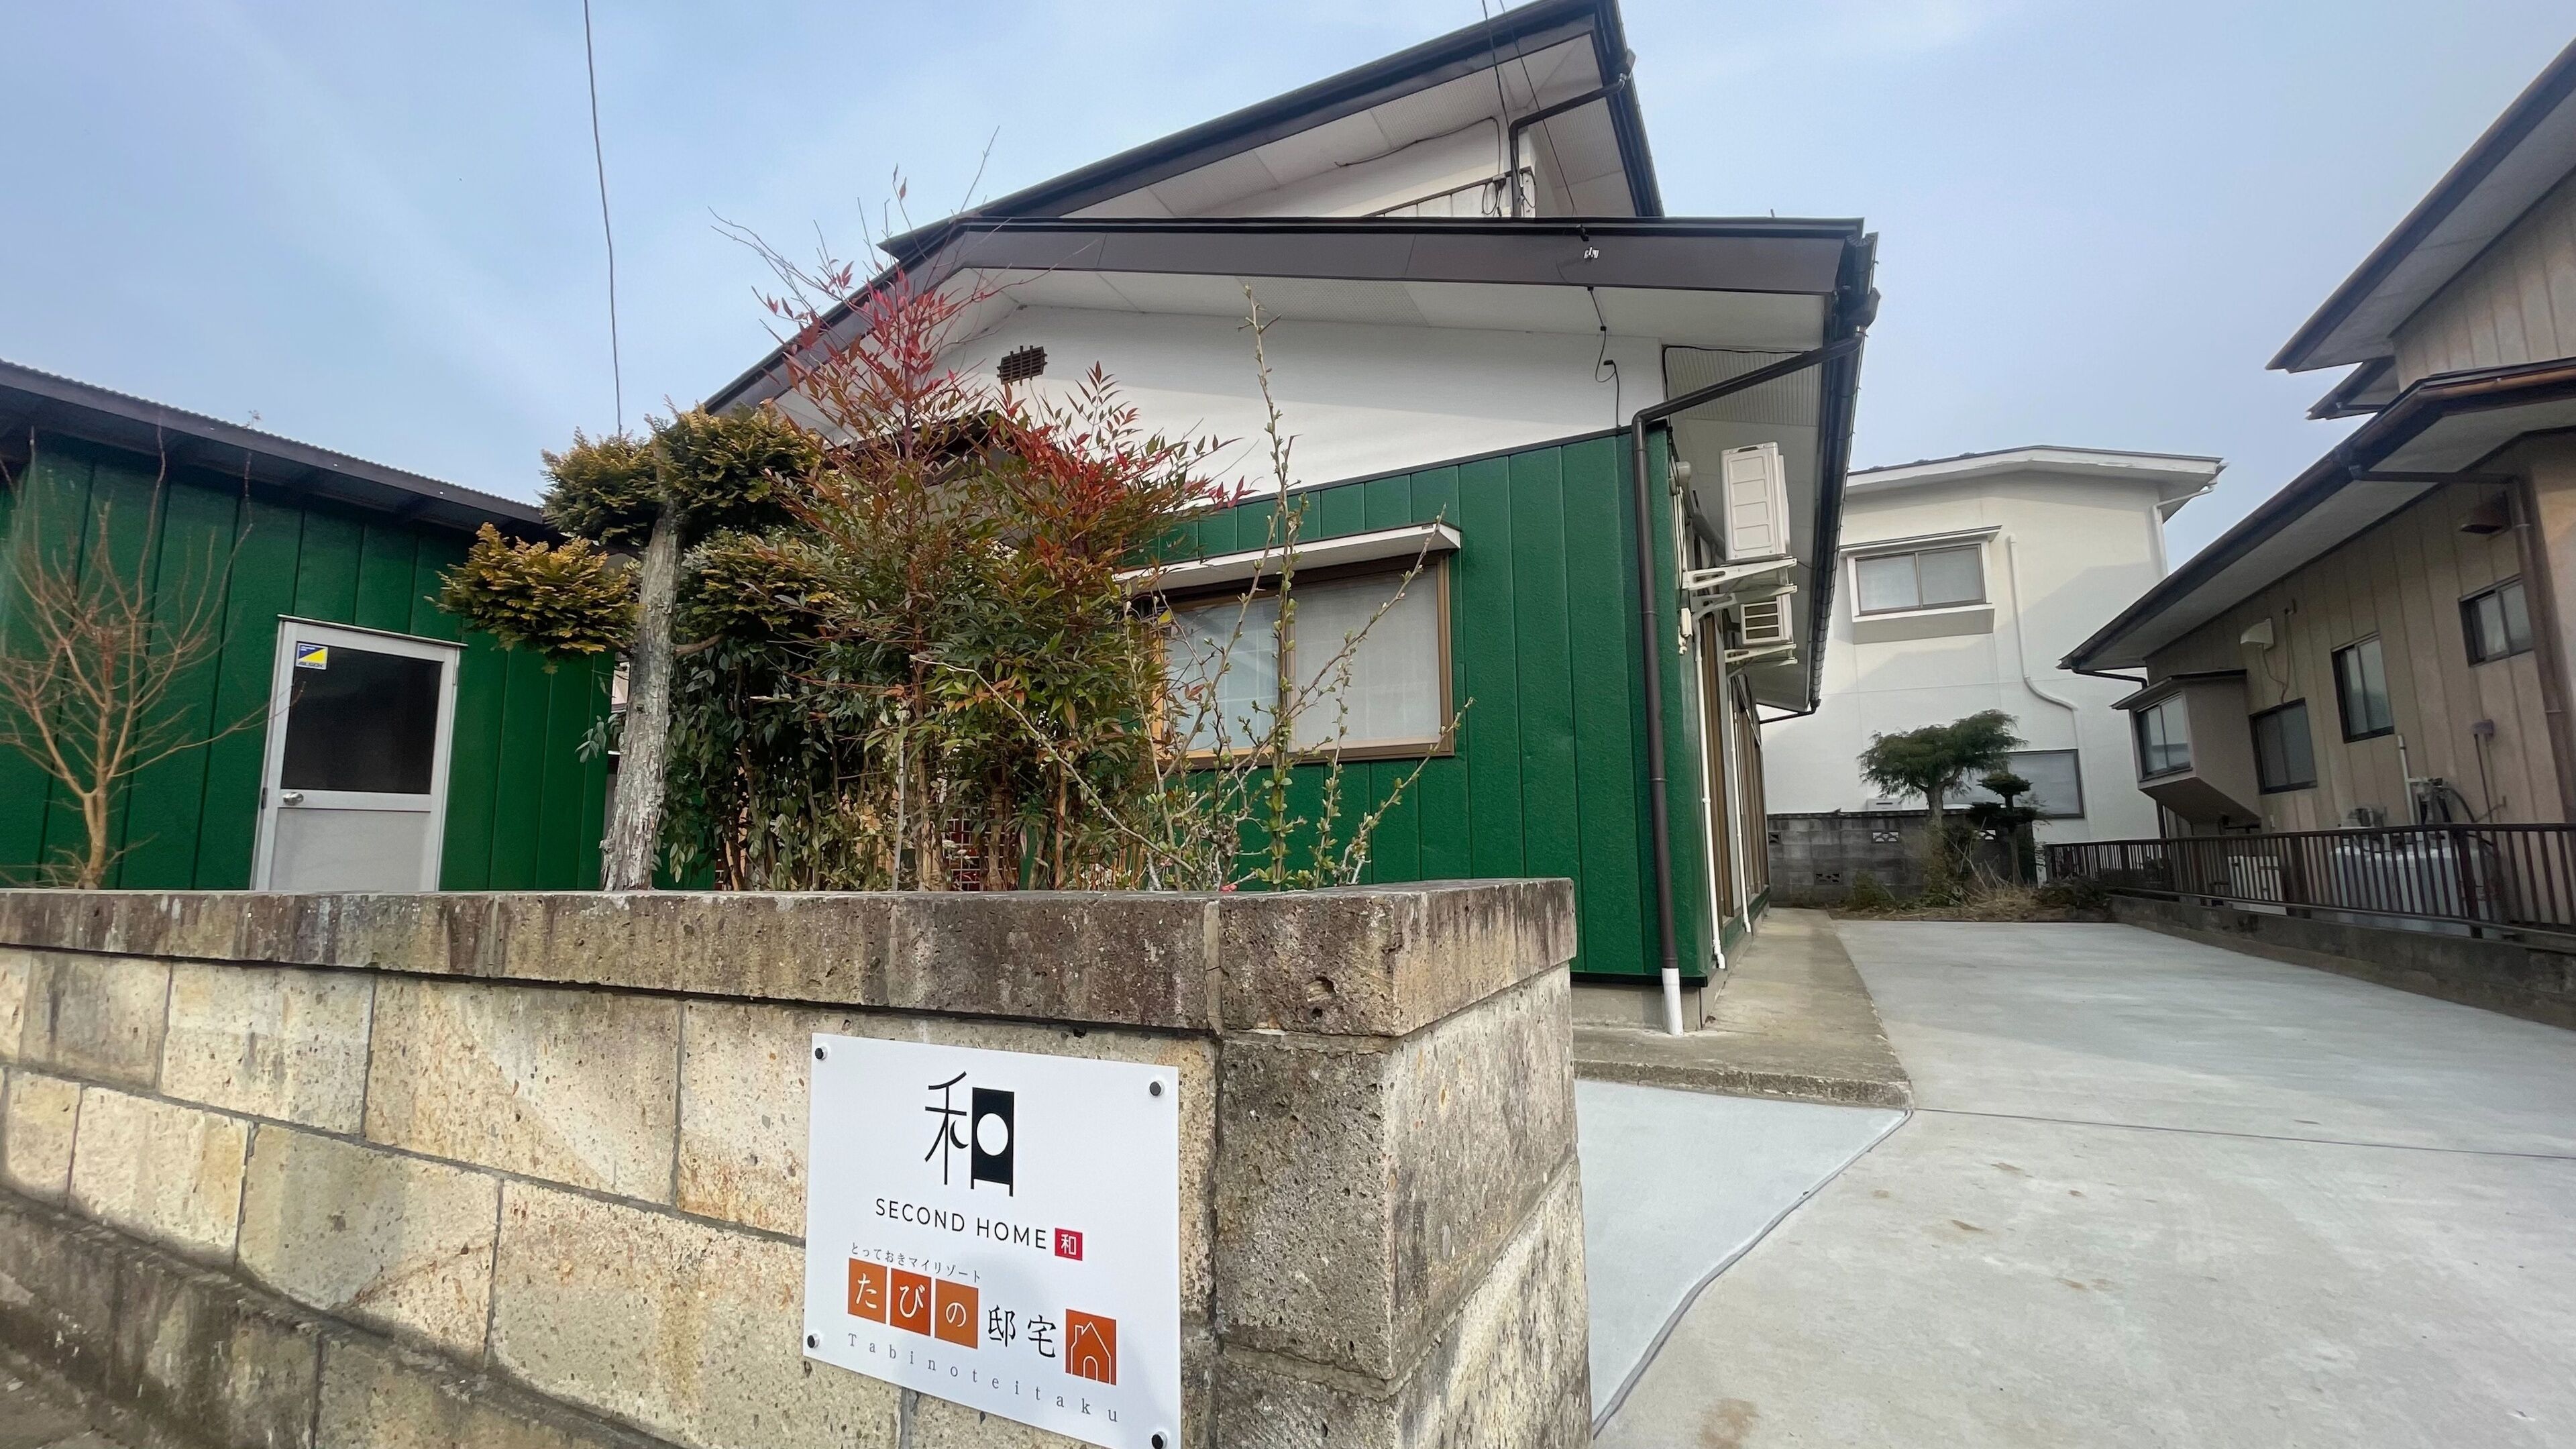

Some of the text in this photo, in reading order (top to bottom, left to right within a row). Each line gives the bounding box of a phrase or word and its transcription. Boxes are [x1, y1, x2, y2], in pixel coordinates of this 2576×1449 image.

[851, 1242, 981, 1283] とっておきマイリゾート
[875, 1198, 1077, 1256] SECOND HOME 和
[855, 1273, 1057, 1358] たびの邸宅
[848, 1332, 1118, 1423] Tabinoteitaku
